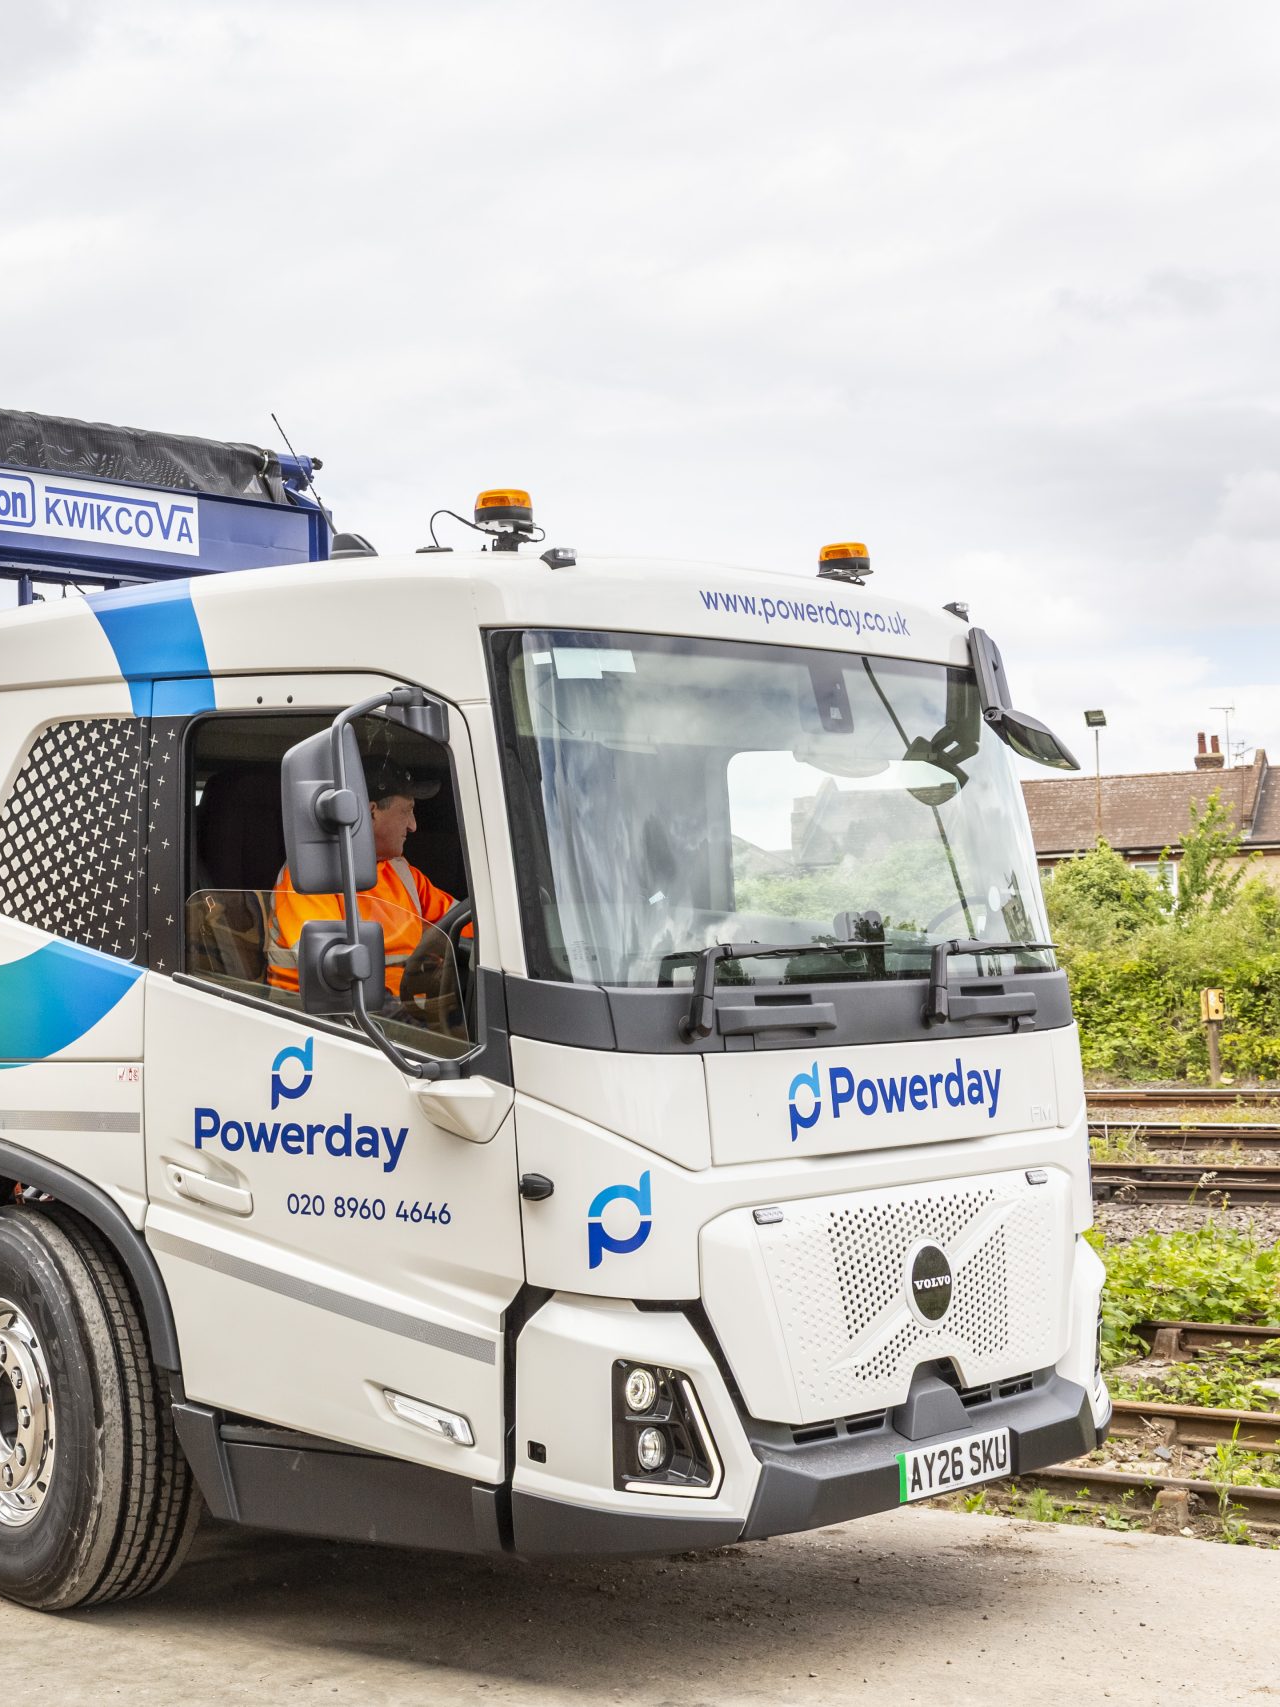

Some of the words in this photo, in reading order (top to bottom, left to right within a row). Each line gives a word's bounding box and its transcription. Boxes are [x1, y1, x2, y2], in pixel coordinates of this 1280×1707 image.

[699, 590, 911, 637] www.powerday.co.uk
[829, 1058, 1002, 1119] Powerday
[194, 1107, 410, 1173] Powerday
[287, 1193, 325, 1217] 020
[334, 1196, 386, 1221] 8960
[395, 1200, 452, 1225] 4646
[913, 1274, 951, 1290] VOLVO
[911, 1446, 964, 1493] AY26
[969, 1434, 1007, 1476] SKU
